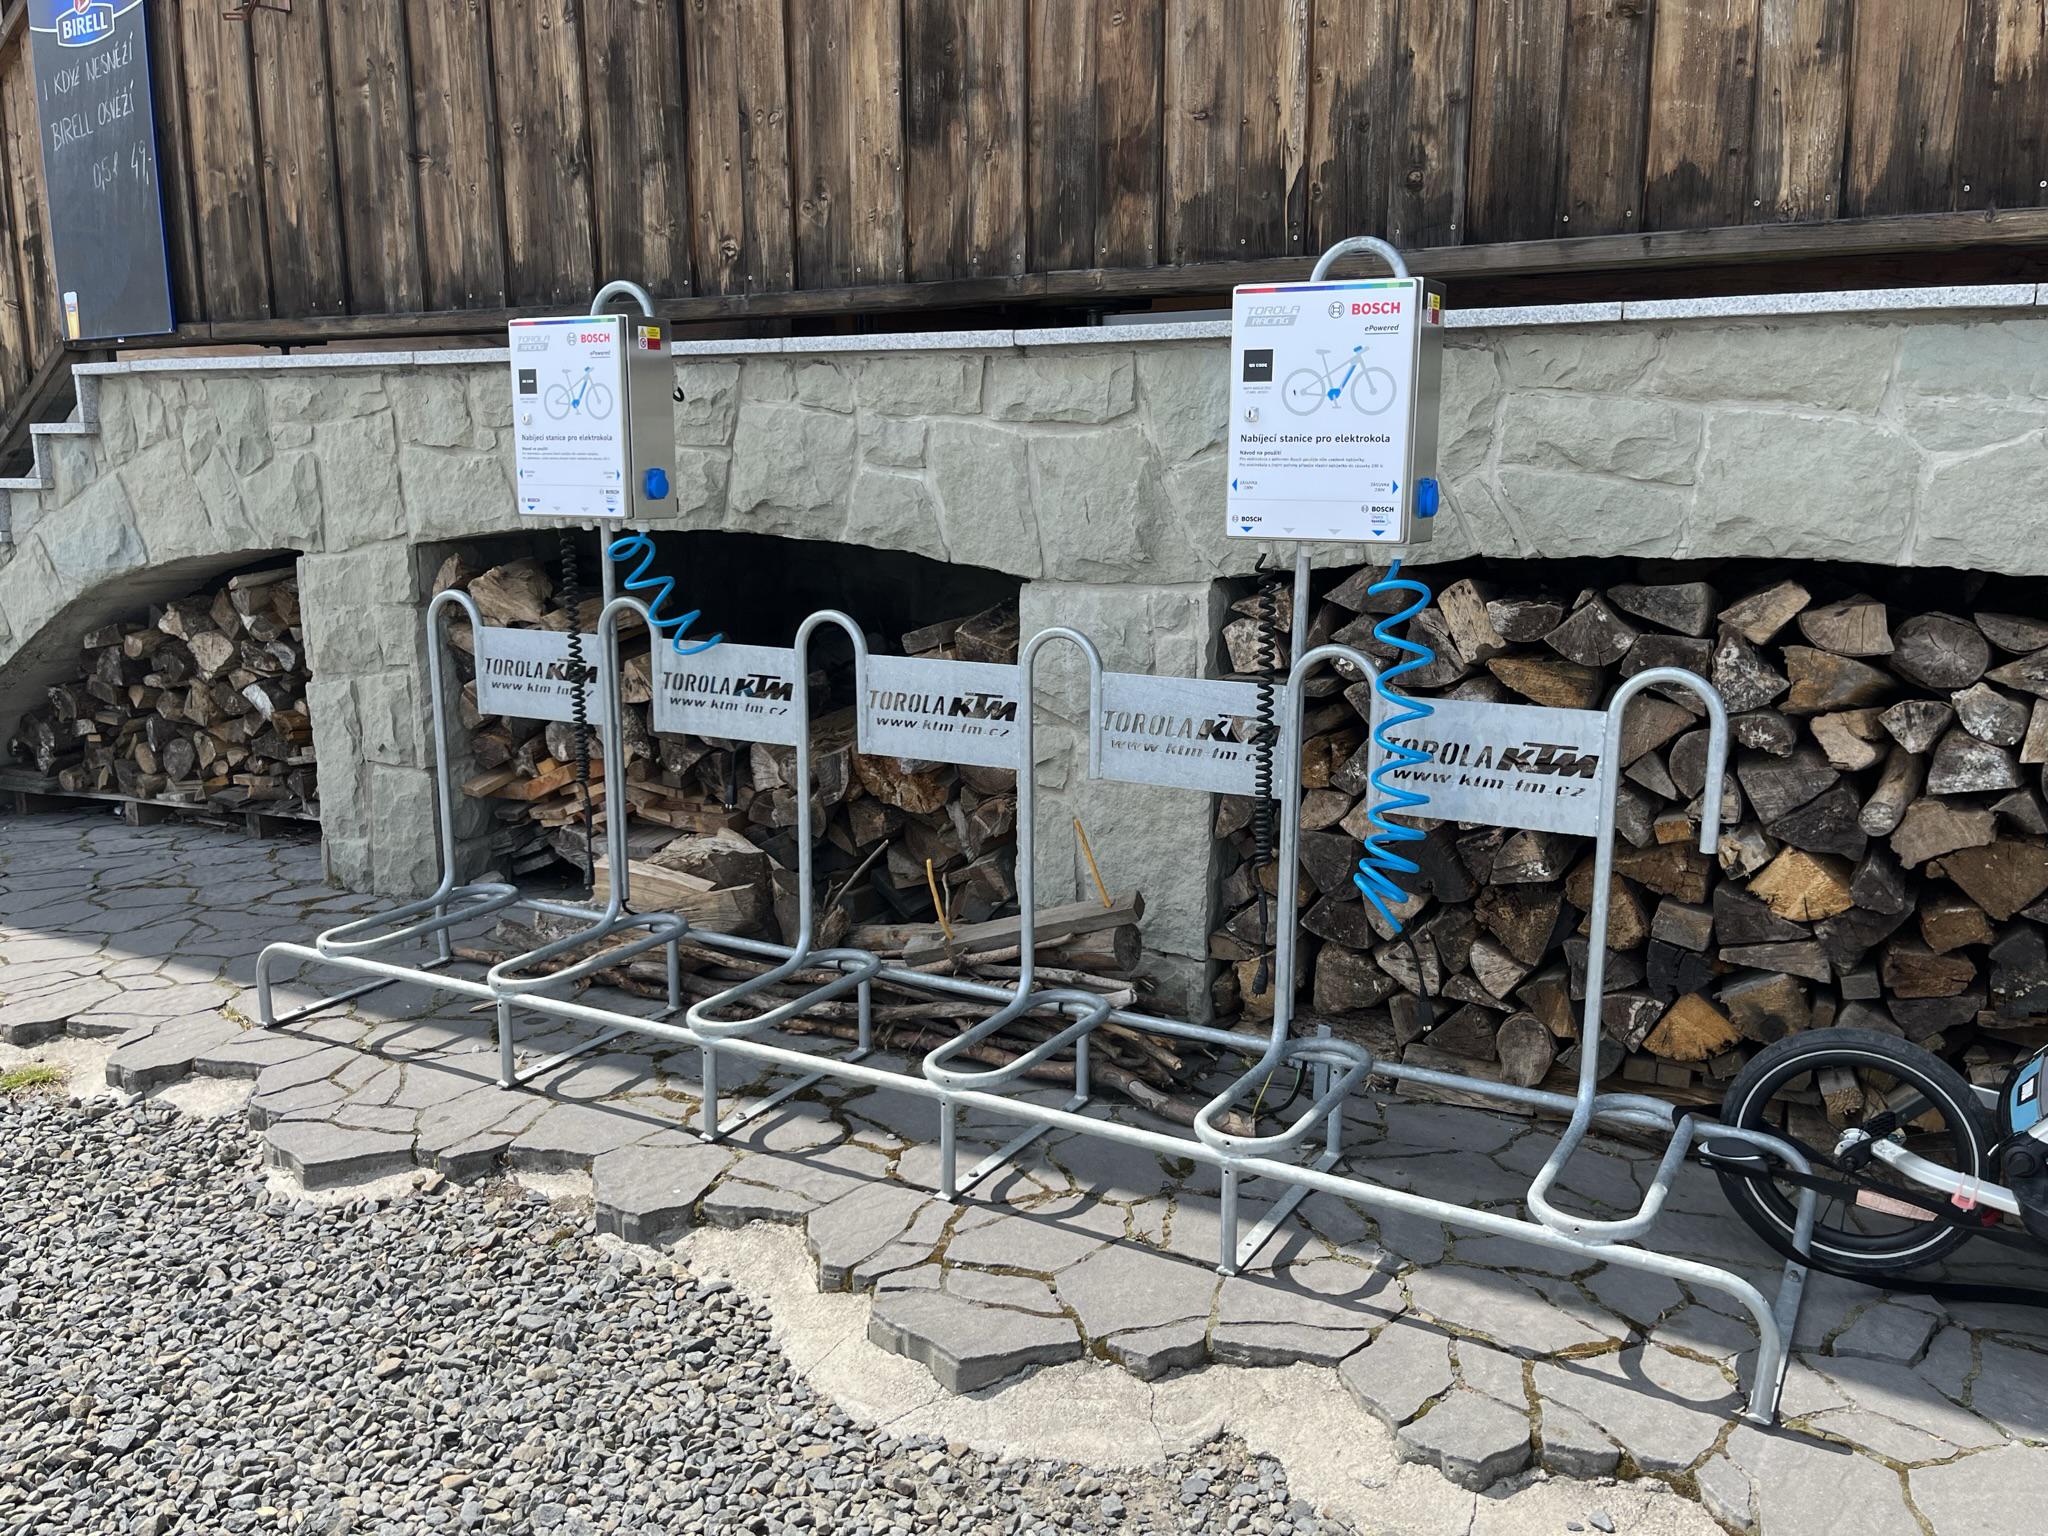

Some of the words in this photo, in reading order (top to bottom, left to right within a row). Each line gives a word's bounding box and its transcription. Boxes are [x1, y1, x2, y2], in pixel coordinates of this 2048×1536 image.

[62, 11, 108, 40] BIRELL
[43, 79, 48, 101] I
[51, 111, 94, 152] BIRELL
[1248, 305, 1301, 315] TOROLA
[1352, 302, 1401, 315] BOSCH
[581, 333, 610, 343] BOSCH
[1364, 324, 1400, 332] ePowered
[1240, 434, 1277, 444] Nabíjecí
[1280, 434, 1313, 443] stanice
[1315, 436, 1332, 445] pro
[1335, 434, 1391, 443] elektrokola
[485, 658, 543, 679] TOROLA
[663, 671, 730, 695] TOROLA
[733, 673, 793, 702] KTM
[869, 690, 944, 716] TOROLA
[948, 692, 1018, 722] KTM
[1103, 710, 1192, 739] TOROLA
[1496, 742, 1600, 779] KTM
